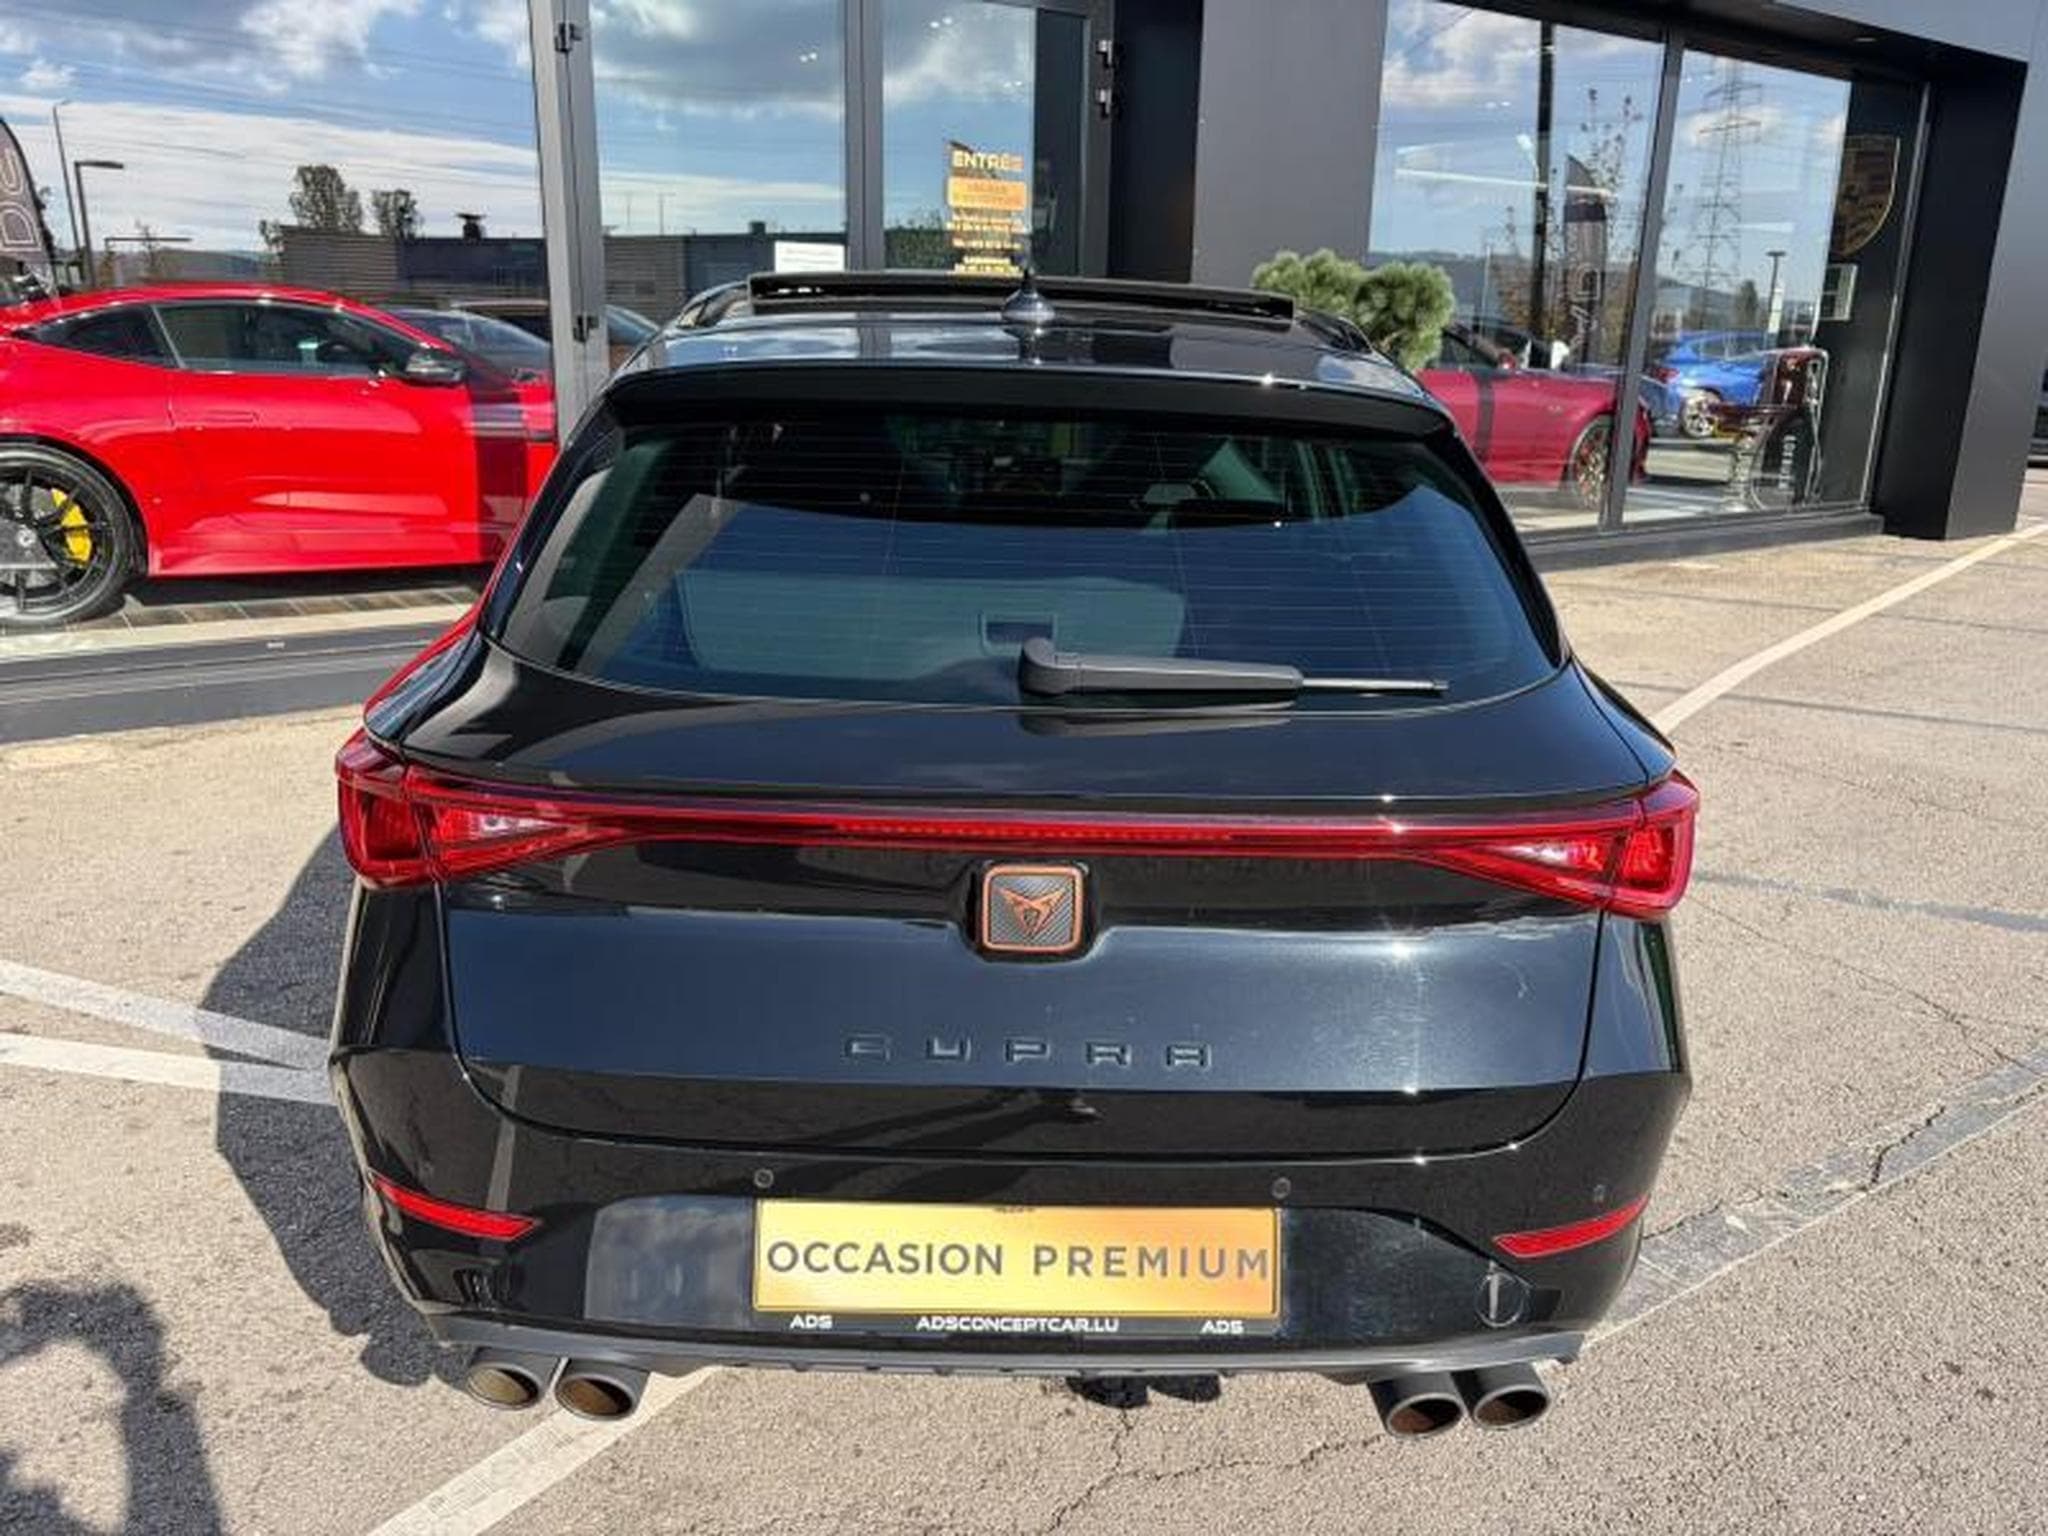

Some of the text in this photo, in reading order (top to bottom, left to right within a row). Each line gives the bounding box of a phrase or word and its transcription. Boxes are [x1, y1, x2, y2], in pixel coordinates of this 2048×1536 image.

[843, 1032, 1213, 1069] CUPRA
[766, 1240, 1270, 1279] OCCASION PREMIUM
[789, 1314, 1245, 1335] ADS ADSCONCEPTCAR.LU ADS
